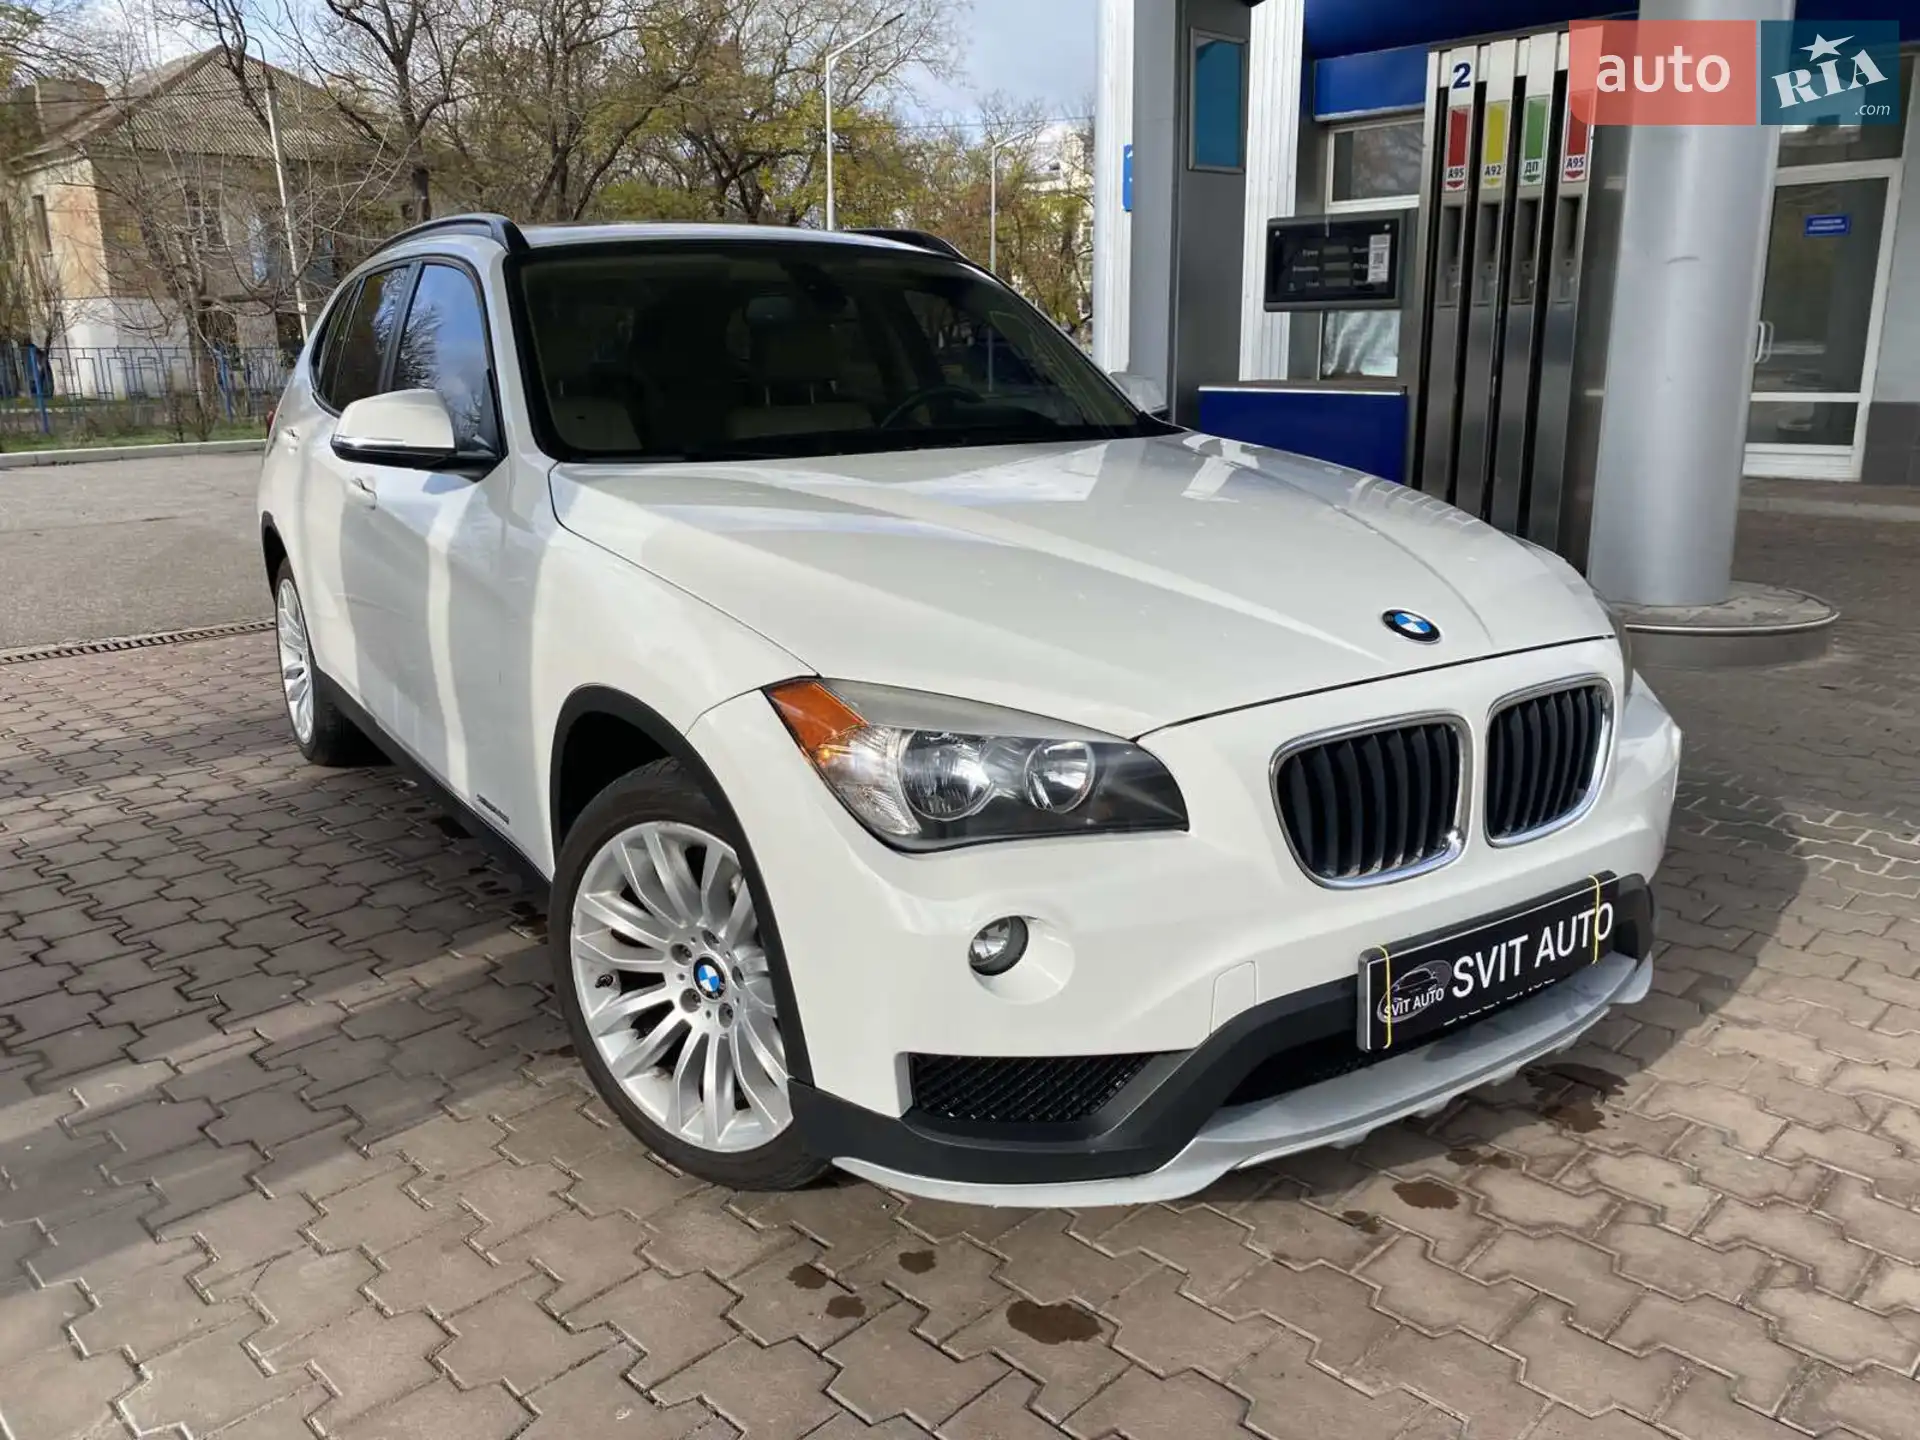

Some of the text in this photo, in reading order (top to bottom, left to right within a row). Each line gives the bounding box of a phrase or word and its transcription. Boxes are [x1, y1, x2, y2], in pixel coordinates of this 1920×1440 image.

[1452, 62, 1471, 89] 2
[1452, 902, 1614, 998] SVIT AUTO
[1412, 987, 1445, 1010] AUTO
